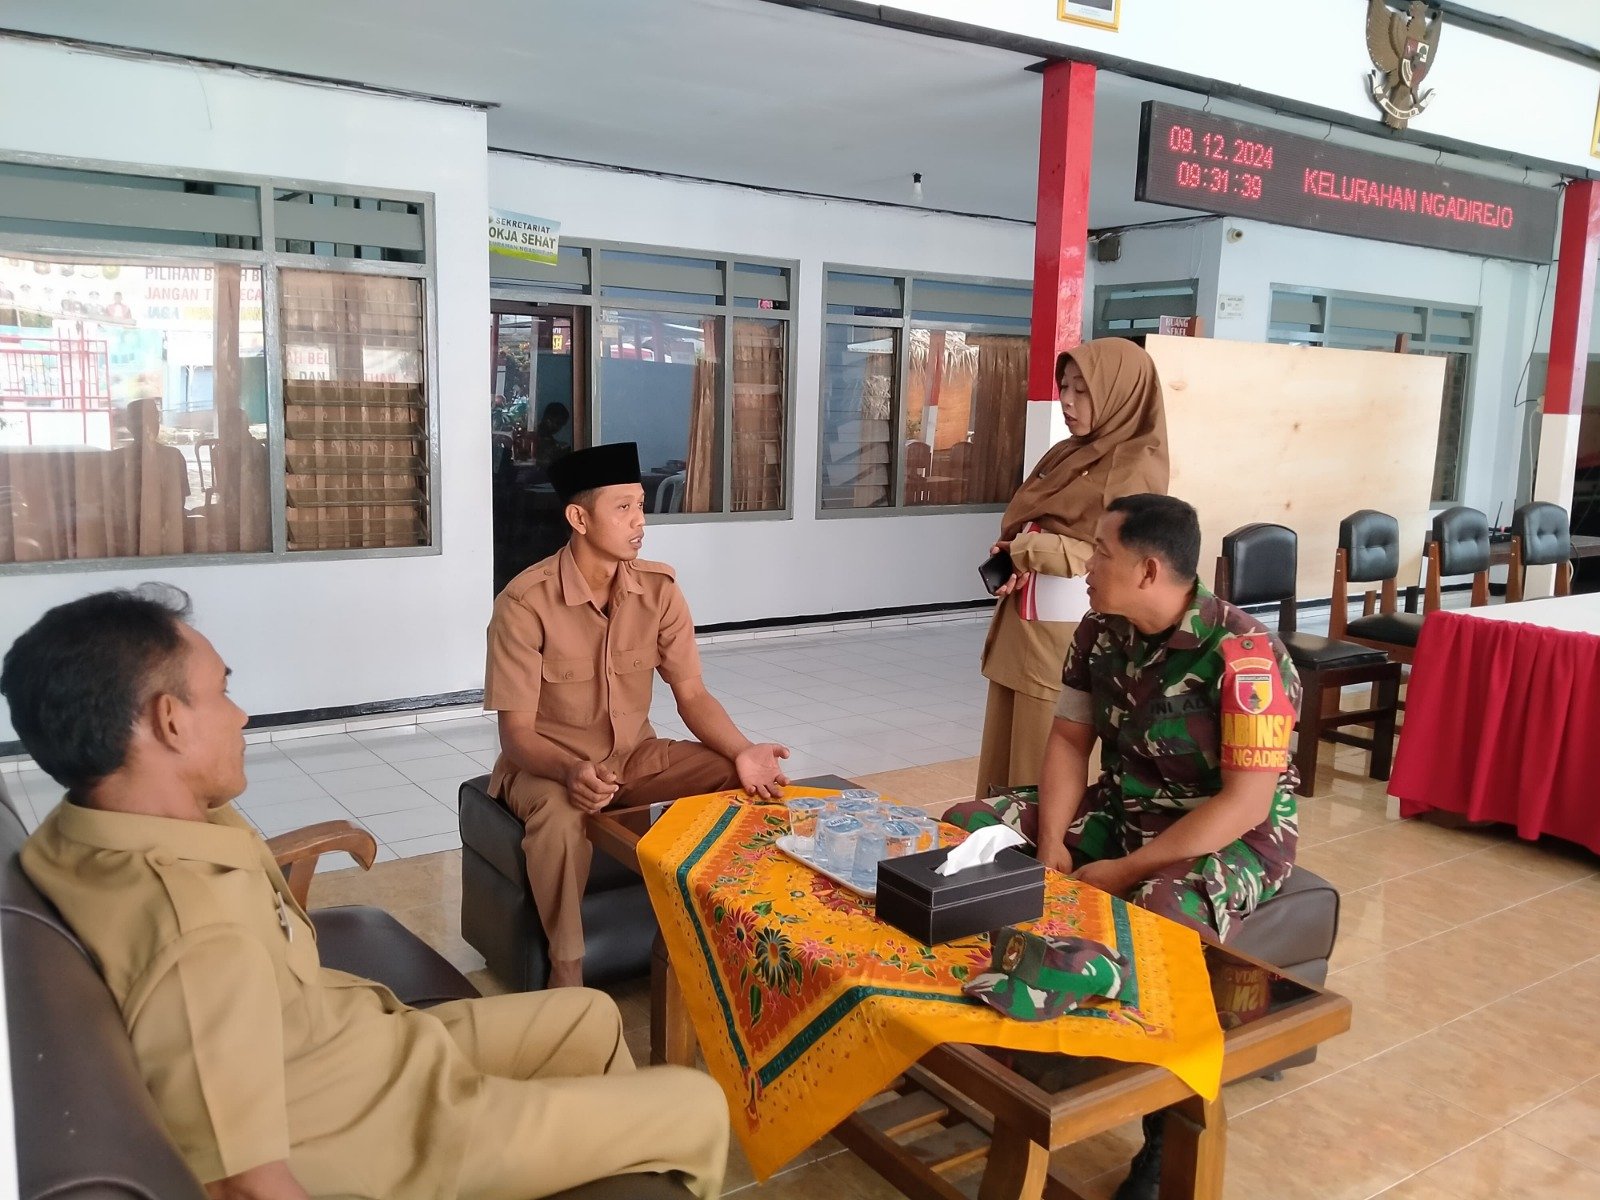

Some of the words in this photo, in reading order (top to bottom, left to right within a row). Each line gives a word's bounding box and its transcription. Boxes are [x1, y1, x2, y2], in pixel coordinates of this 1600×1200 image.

[1304, 168, 1417, 212] KELURAHAN
[1422, 191, 1513, 229] NGADIREJO
[495, 217, 551, 234] SEKRETARIAT
[521, 232, 556, 249] SEHAT
[145, 266, 200, 281] PILIHAN
[145, 287, 199, 301] JANGAN
[1165, 317, 1189, 328] RUANG
